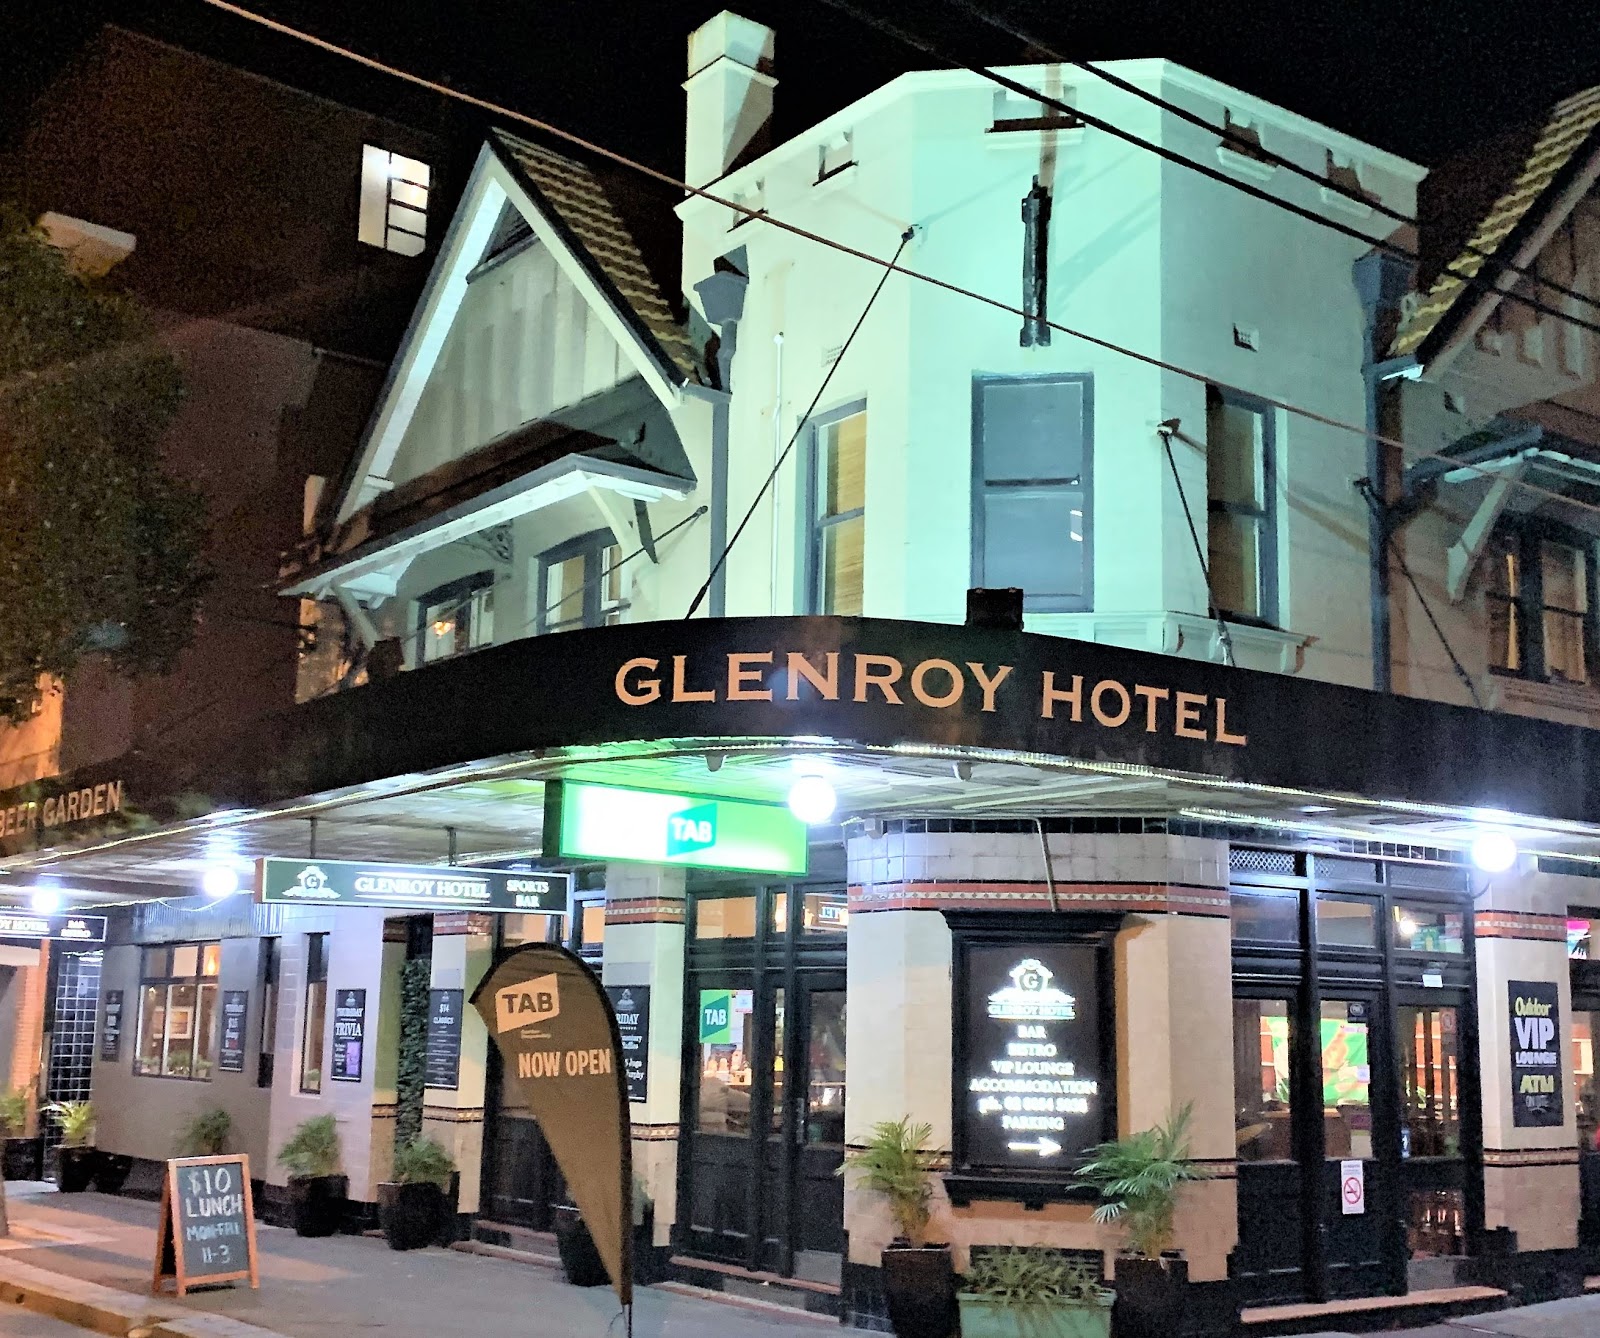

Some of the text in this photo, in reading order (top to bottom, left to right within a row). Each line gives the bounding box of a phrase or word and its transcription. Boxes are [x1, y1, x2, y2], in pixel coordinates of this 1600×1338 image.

[615, 651, 1248, 746] GLENROY HOTEL
[43, 780, 121, 827] GARDEN
[671, 817, 712, 843] TAB
[355, 877, 491, 898] GLENROY HOTEL
[506, 879, 550, 893] SPORTS
[515, 894, 540, 908] BAR
[1023, 973, 1039, 988] G
[502, 992, 553, 1013] TAB
[1515, 996, 1552, 1016] Outdoor
[616, 1013, 640, 1025] RIDAY
[704, 1009, 727, 1026] TAB
[336, 1023, 362, 1036] TRIVIA
[1017, 1025, 1047, 1039] BAR
[1514, 1017, 1555, 1049] VIP
[519, 1048, 611, 1078] NOW OPEN
[1515, 1052, 1556, 1065] LOUNGE
[991, 1060, 1075, 1075] VIP LOUNGE
[969, 1078, 1097, 1095] ACCOMMODATION
[1520, 1075, 1554, 1093] ATM
[1002, 1115, 1064, 1130] PARKING
[188, 1167, 232, 1197] $10
[185, 1193, 243, 1217] LUNCH
